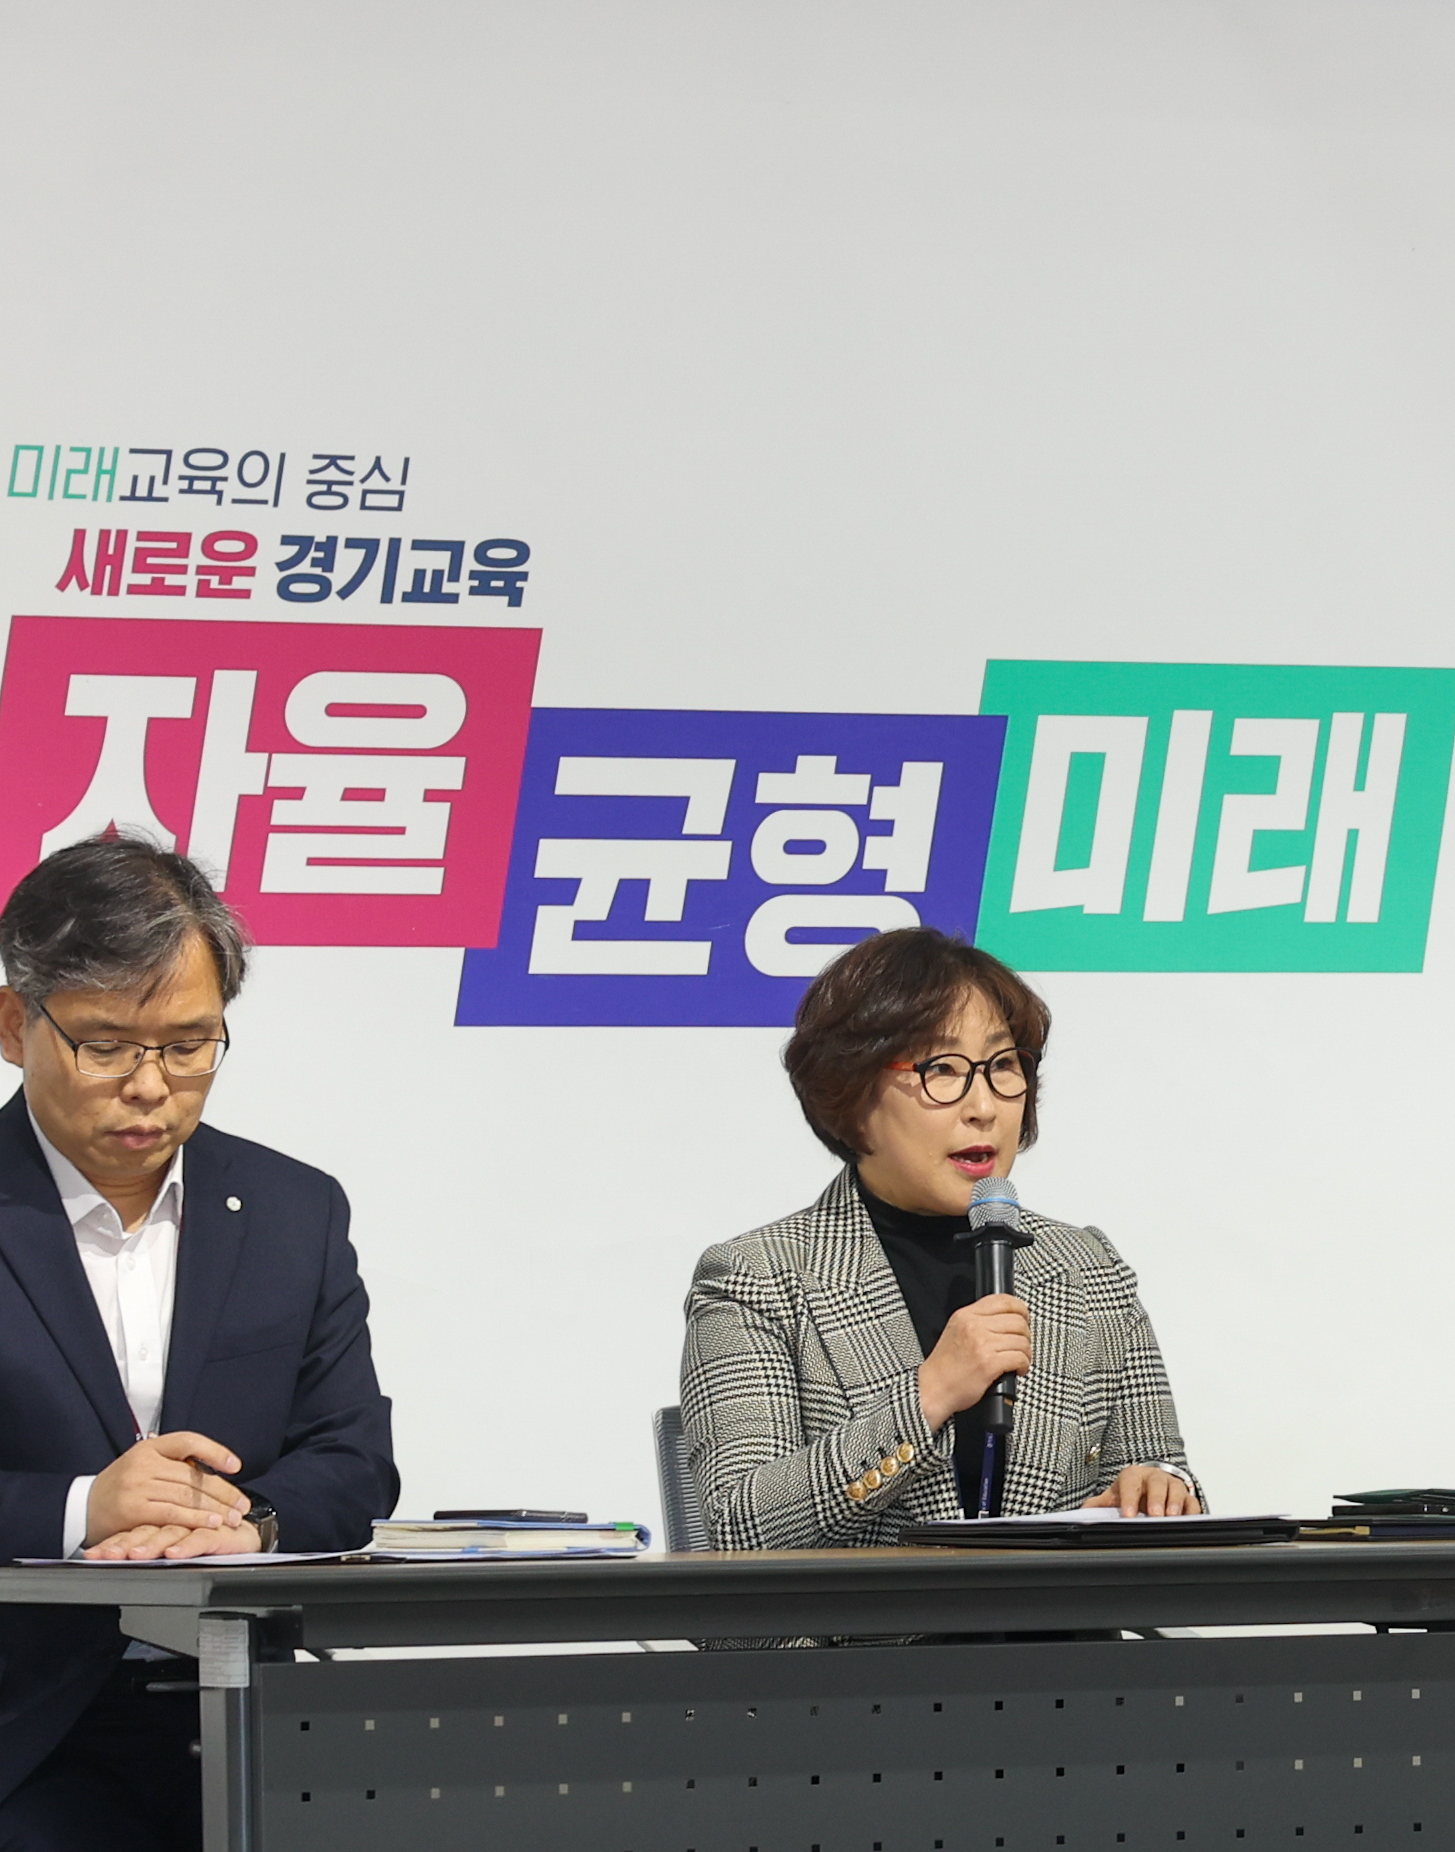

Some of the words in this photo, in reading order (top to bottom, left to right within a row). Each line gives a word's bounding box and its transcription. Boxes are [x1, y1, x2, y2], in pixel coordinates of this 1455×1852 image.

[6, 444, 287, 508] 미래교육의
[305, 453, 411, 512] 중심
[54, 527, 259, 600] 새로운
[274, 534, 532, 608] 경기교육
[38, 668, 467, 896] 자율
[527, 754, 944, 977] 균형
[1009, 709, 1408, 923] 미래
